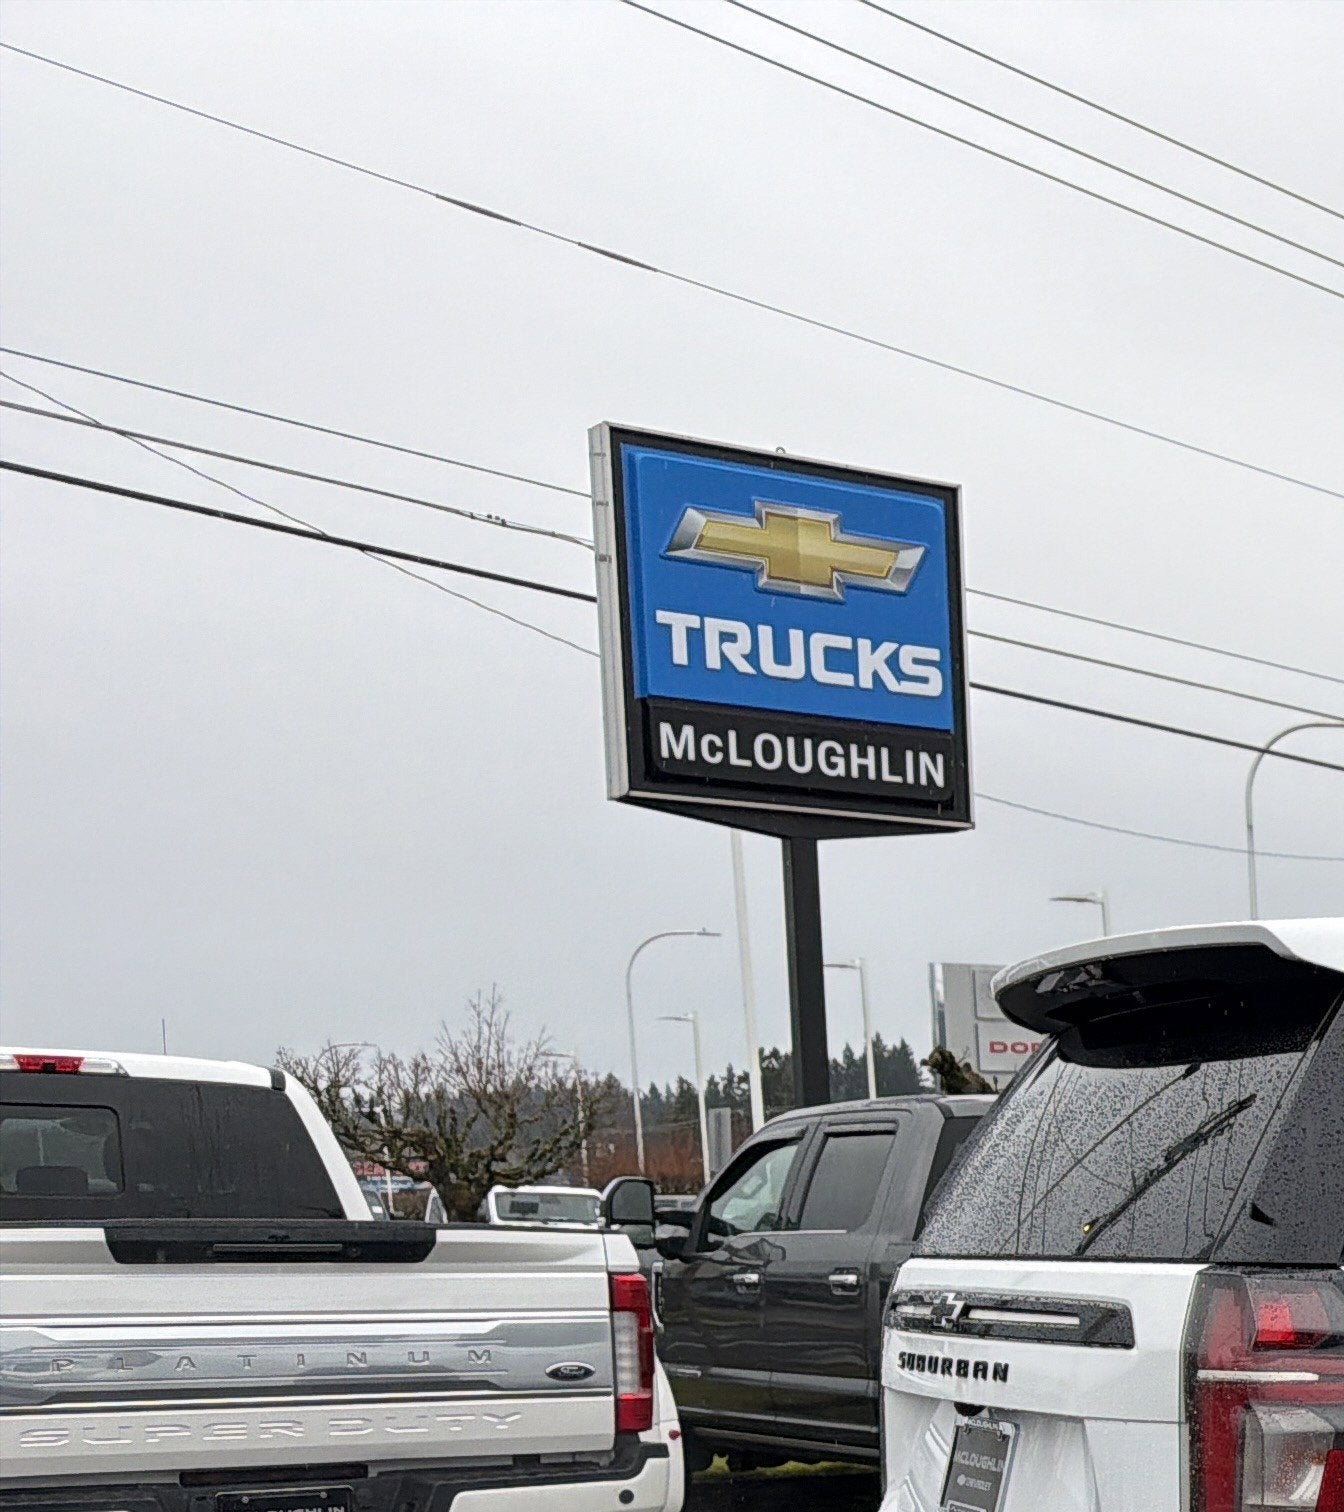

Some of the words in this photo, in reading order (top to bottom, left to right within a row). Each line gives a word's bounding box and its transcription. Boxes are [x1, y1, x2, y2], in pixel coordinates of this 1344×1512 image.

[656, 610, 943, 697] TRUCKS
[659, 721, 945, 788] McLOUGHLIN
[52, 1349, 492, 1373] PLATINUM
[898, 1351, 1009, 1383] SUBURBAN
[20, 1420, 304, 1448] SUPER
[329, 1411, 522, 1436] DUTY
